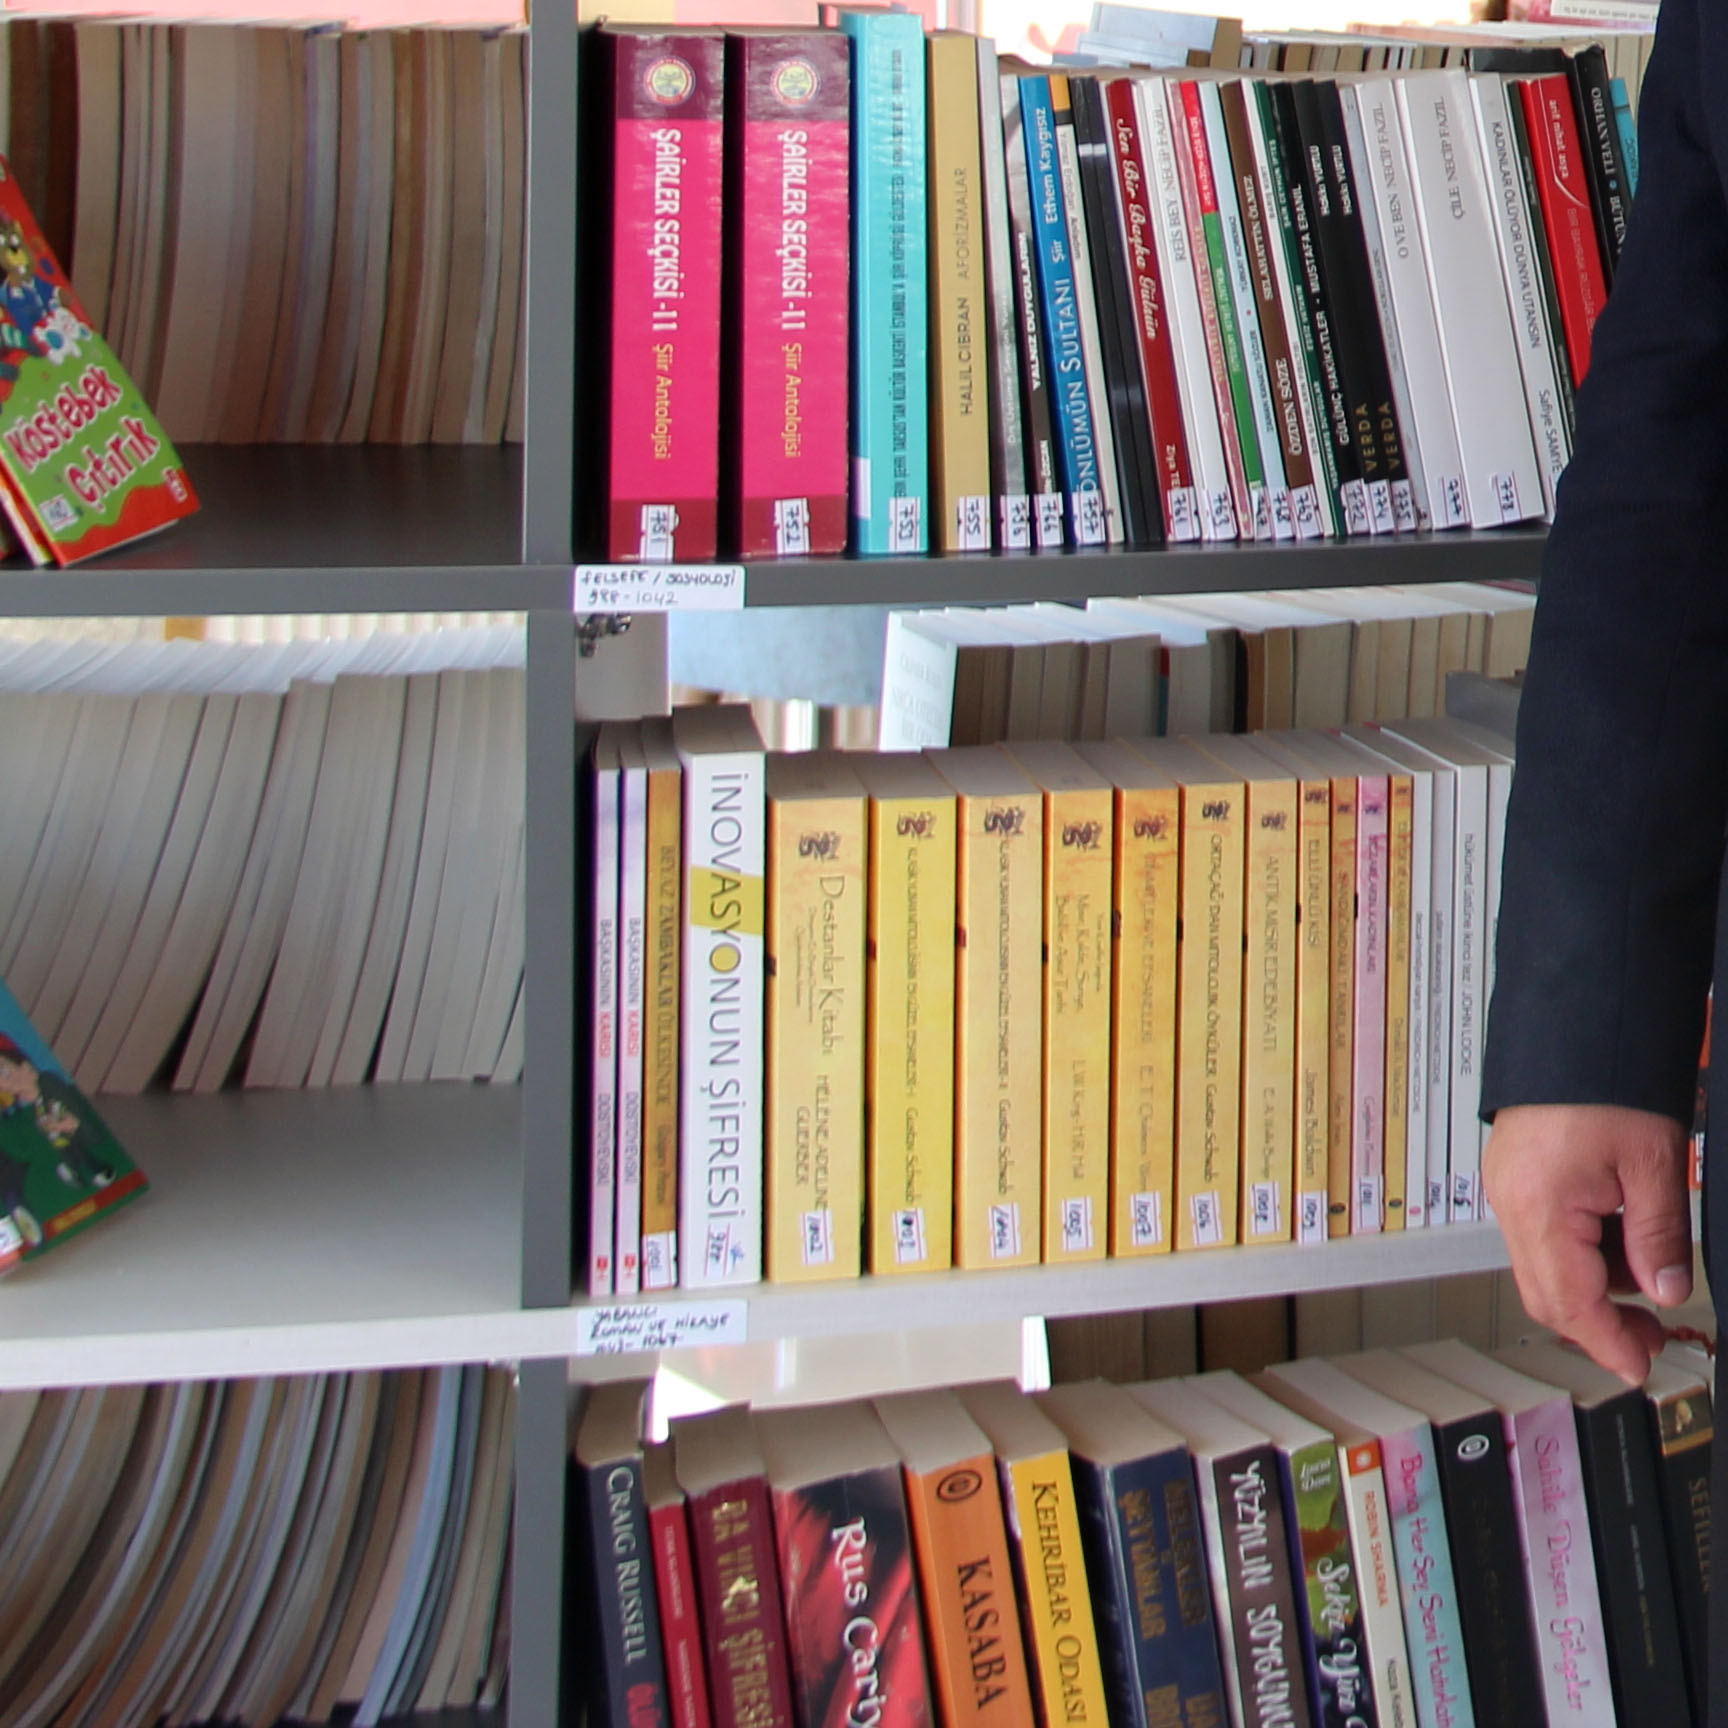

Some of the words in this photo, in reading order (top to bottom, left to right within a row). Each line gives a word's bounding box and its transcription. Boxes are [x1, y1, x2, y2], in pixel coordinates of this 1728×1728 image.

[1035, 106, 1054, 171] Kaygısız
[1117, 117, 1134, 154] Sen
[1372, 101, 1389, 148] FAZIL
[1433, 95, 1451, 140] FAZIL
[1553, 123, 1567, 152] nihat
[1590, 87, 1608, 131] ORHAN
[650, 128, 687, 215] ŞAİRLER
[777, 128, 813, 215] ŞAİRLER
[1122, 156, 1141, 200] Bir
[1381, 151, 1398, 188] NECİP
[1441, 145, 1458, 188] NECİP
[1493, 121, 1513, 186] KADINLAR
[1557, 155, 1570, 179] asya
[954, 167, 969, 280] AFORİZMALAR
[1043, 173, 1059, 225] Ethem
[1167, 197, 1183, 226] BEY
[1448, 191, 1464, 220] ÇİLE
[1502, 187, 1523, 236] ÖLÜYOR
[647, 220, 685, 299] SEÇKİSİ
[775, 220, 813, 299] SEÇKİSİ
[1051, 239, 1067, 264] Şiir
[1128, 203, 1152, 270] Başka
[1300, 231, 1324, 294] MUSTAFA
[1511, 237, 1532, 287] DÜNYA
[1017, 230, 1038, 333] DUYGULARIM
[1054, 277, 1082, 374] SULTANI
[1317, 309, 1341, 390] HAKİKATLER
[1521, 289, 1543, 350] UTANSIN
[652, 343, 674, 372] Şiir
[781, 343, 802, 372] Şiir
[1026, 334, 1042, 391] YALNIZ
[4, 364, 123, 473] Köstebek
[650, 375, 673, 460] Antolojisi
[780, 374, 802, 459] Antolojisi
[1064, 381, 1098, 494] ÖNLÜMÜN
[1330, 391, 1351, 447] GÜLÜNÇ
[1354, 402, 1378, 472] VERDA
[1378, 401, 1401, 470] VERDA
[708, 772, 749, 1067] İNOVASYONUN
[819, 874, 846, 985] Destanlar
[598, 919, 612, 1006] BAŞKASININ
[626, 917, 641, 1005] BAŞKASININ
[599, 1010, 612, 1059] KARISI
[626, 1010, 641, 1057] KARISI
[700, 1078, 747, 1221] ŞİFRESİ
[607, 1466, 638, 1556] CRAIG
[1362, 1490, 1378, 1538] ROBIN
[1400, 1455, 1424, 1514] Bana
[1228, 1459, 1275, 1591] YÜZYILIN
[1407, 1516, 1430, 1554] Her
[831, 1515, 870, 1607] Rus
[1367, 1540, 1387, 1608] SHARMA
[616, 1558, 648, 1666] RUSSELL
[1030, 1480, 1073, 1629] KEHRİBAR
[1055, 1634, 1088, 1725] ODASI
[1317, 1557, 1354, 1633] Sekiz
[1418, 1594, 1444, 1643] Seni
[956, 1553, 1008, 1711] KASABA
